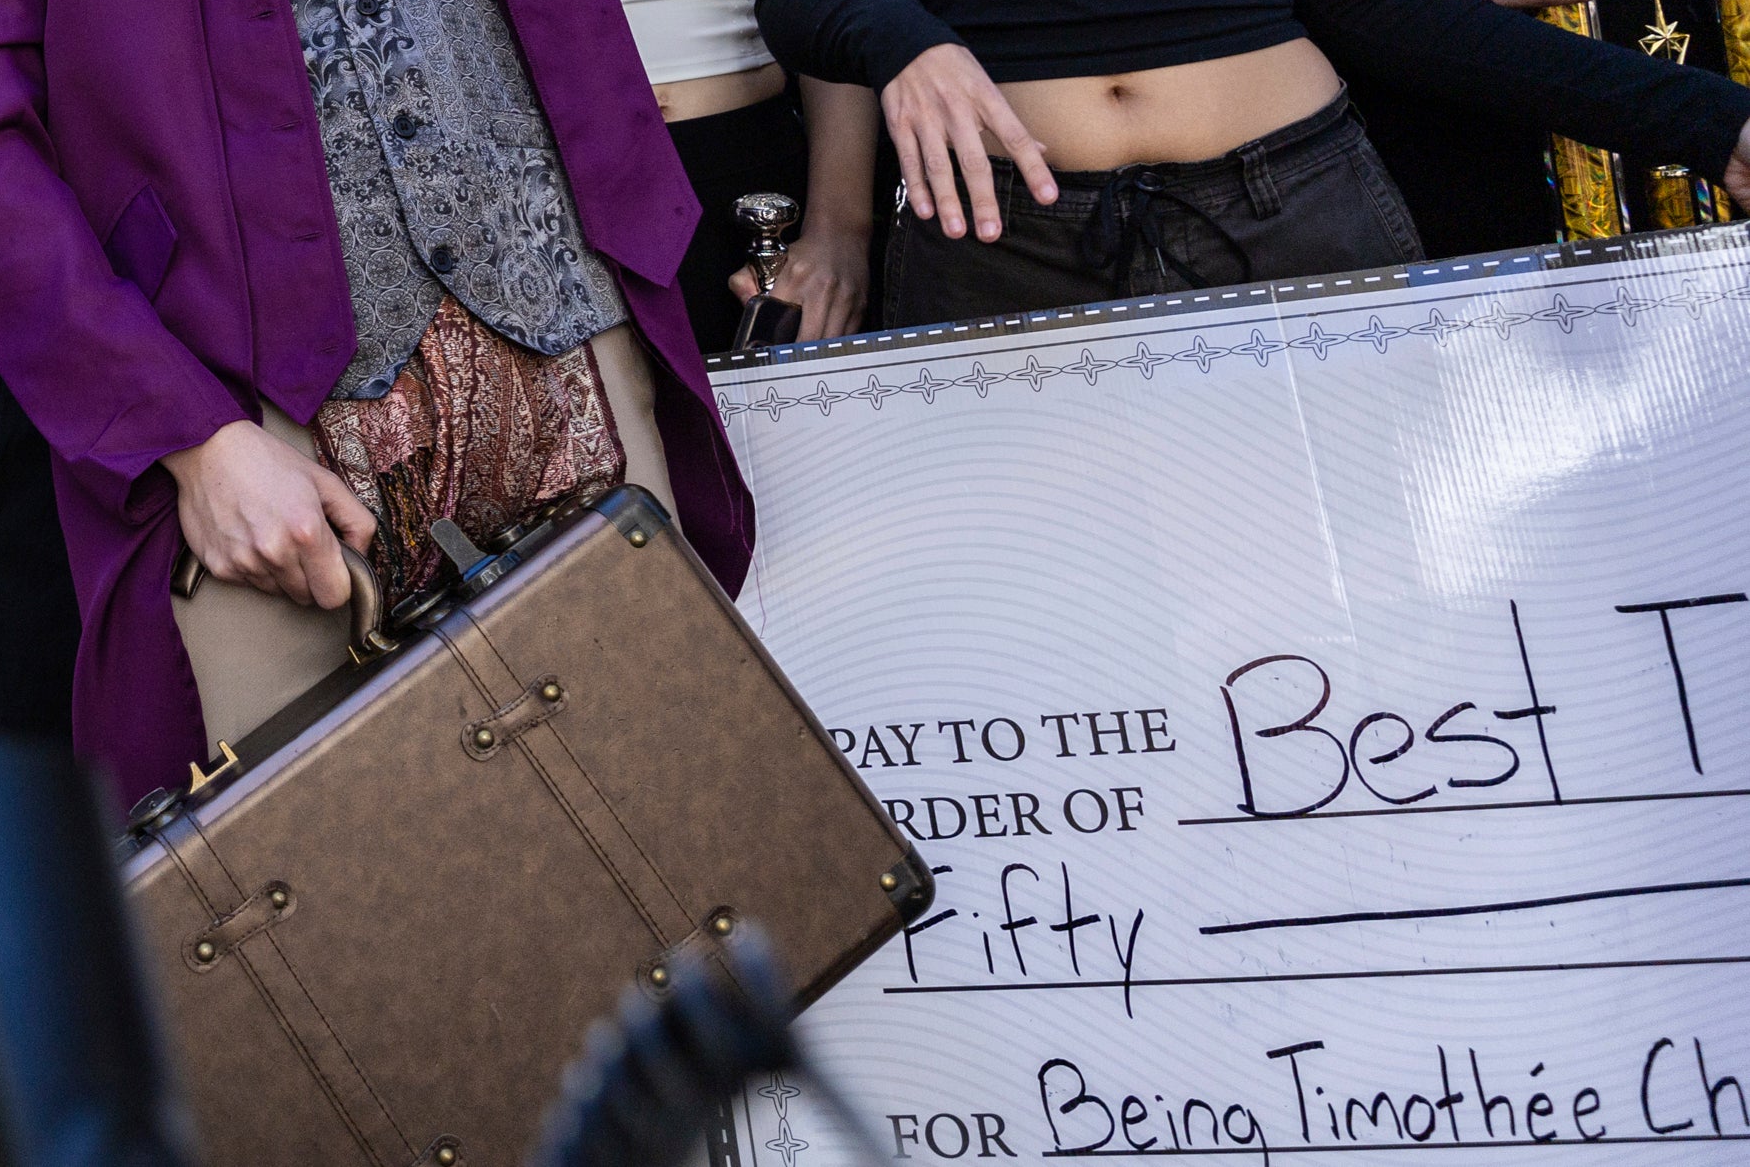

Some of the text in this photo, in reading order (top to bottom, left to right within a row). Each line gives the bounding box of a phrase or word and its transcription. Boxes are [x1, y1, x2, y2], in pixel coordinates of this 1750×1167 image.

[937, 717, 1026, 764] TO
[1040, 708, 1177, 758] THE
[1219, 592, 1750, 818] Best T
[882, 786, 1146, 841] RDER OF
[902, 860, 1145, 1020] Fifty
[885, 1112, 1019, 1160] FOR
[1038, 1036, 1750, 1167] Being Timothée Ch
